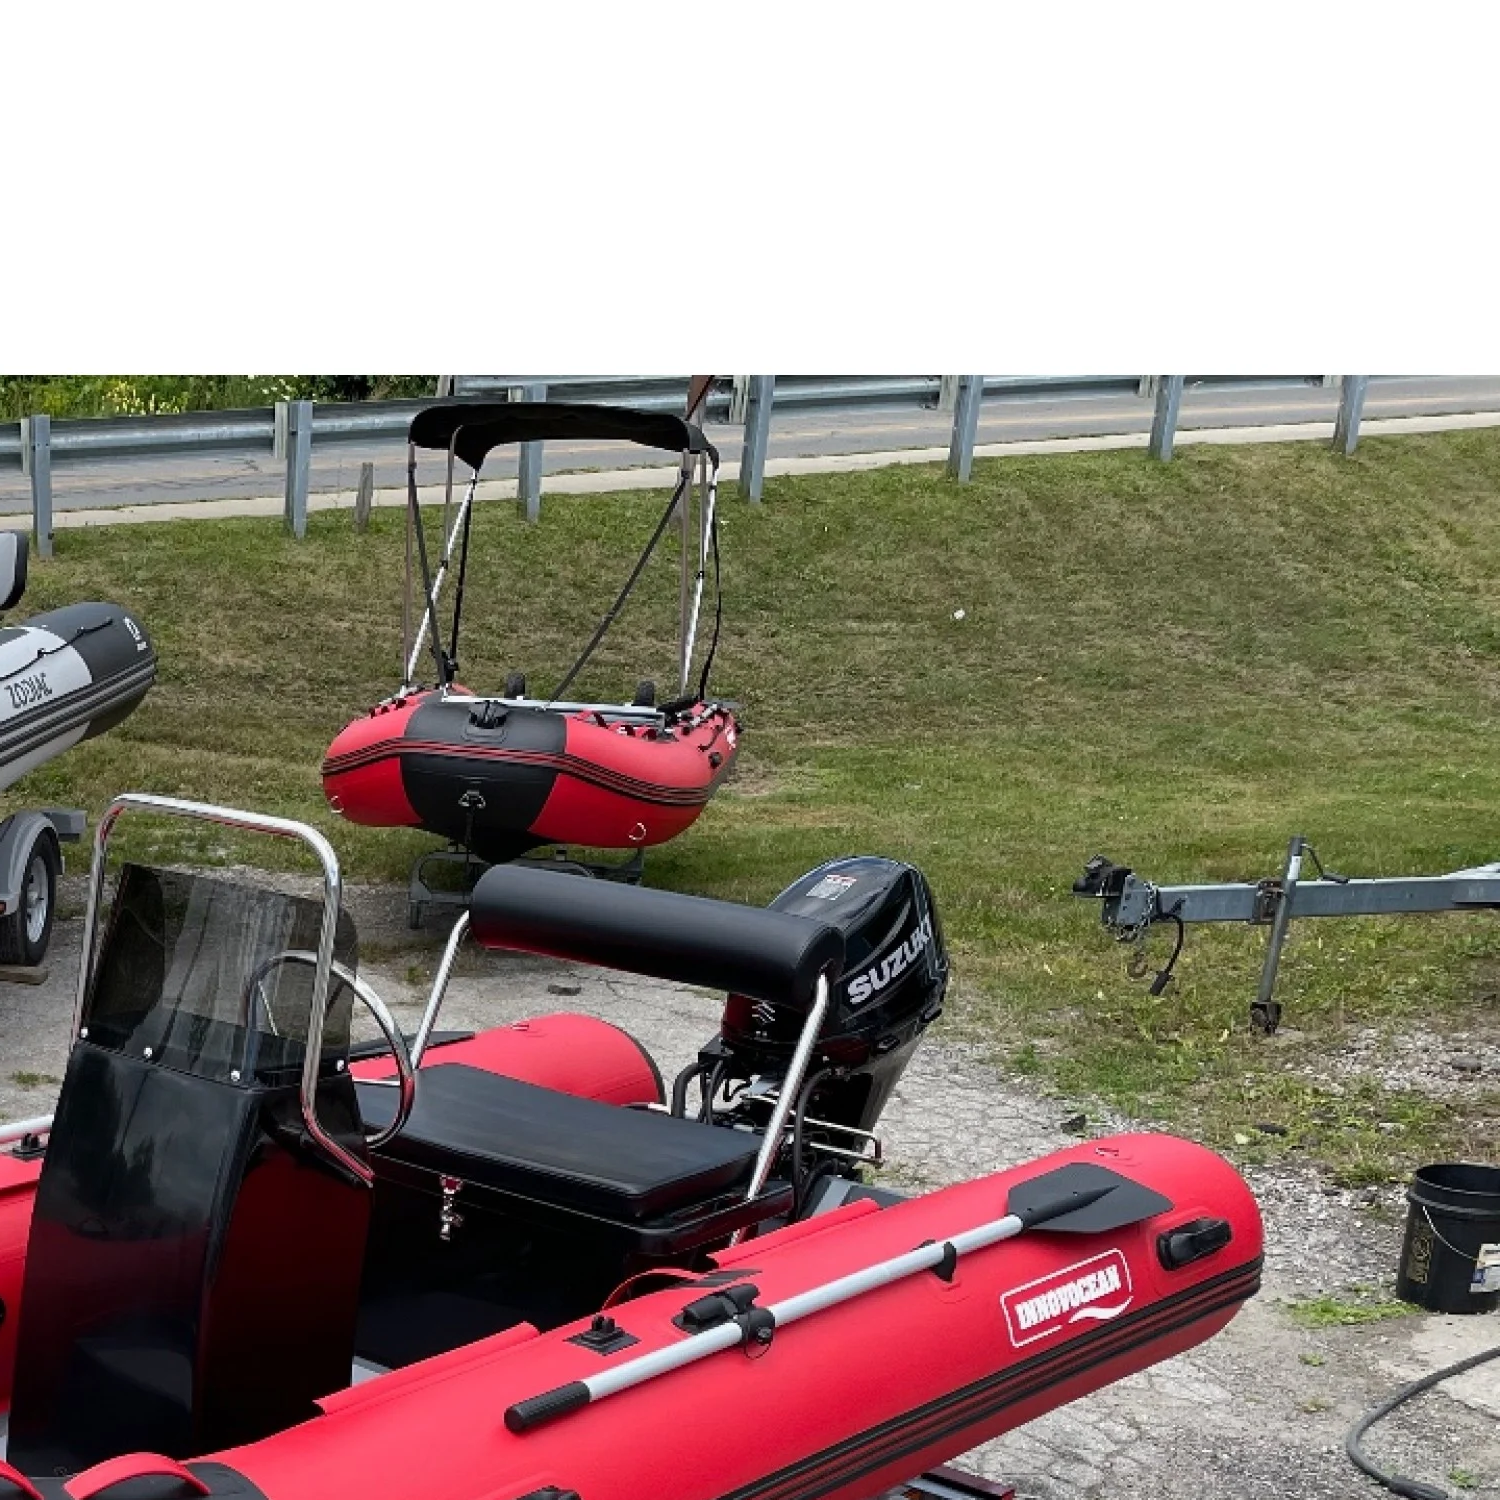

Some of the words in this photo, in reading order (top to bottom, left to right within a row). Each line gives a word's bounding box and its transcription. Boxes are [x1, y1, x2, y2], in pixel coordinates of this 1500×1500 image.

[4, 672, 52, 708] ZODIAC
[847, 912, 931, 1005] SUZUKI
[1014, 1263, 1122, 1330] INNOVOCEAN
